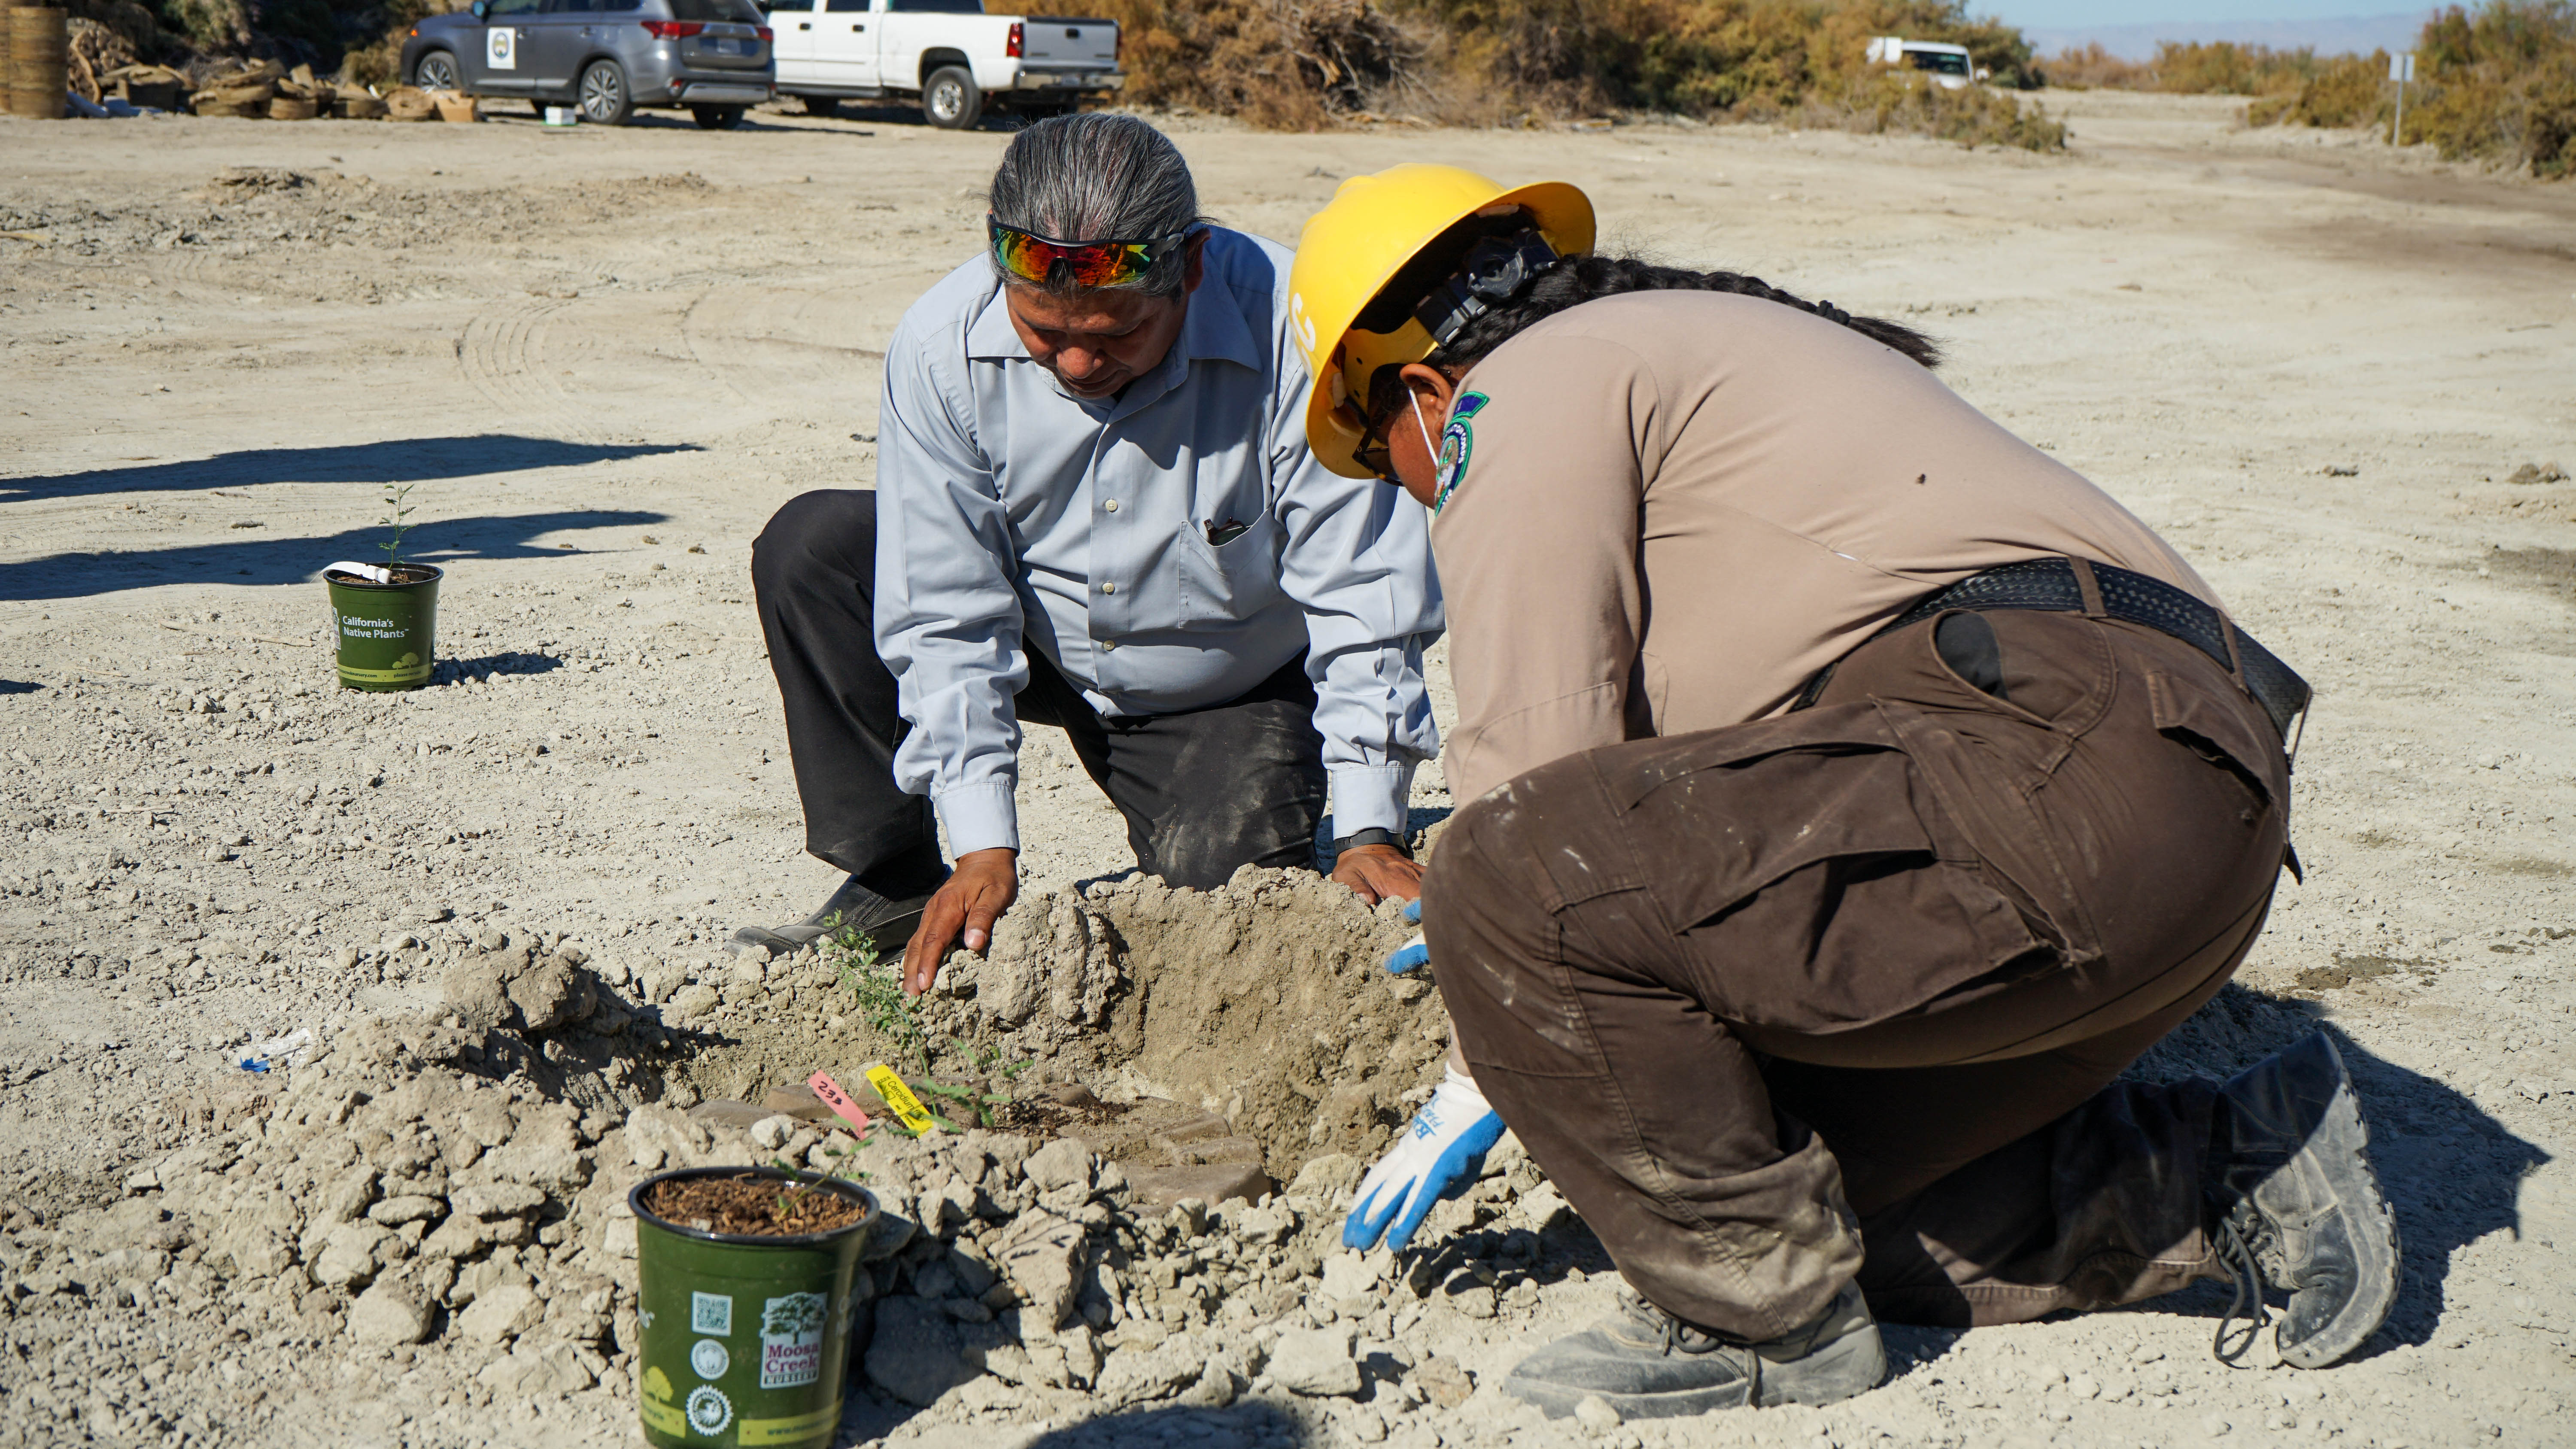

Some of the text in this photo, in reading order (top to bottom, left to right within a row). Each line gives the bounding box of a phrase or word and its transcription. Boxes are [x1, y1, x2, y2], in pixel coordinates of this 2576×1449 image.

[342, 615, 394, 628] California's
[343, 626, 372, 638] Native
[888, 1080, 915, 1110] Cercidium
[768, 1343, 818, 1358] Moosa
[766, 1355, 817, 1373] Creek
